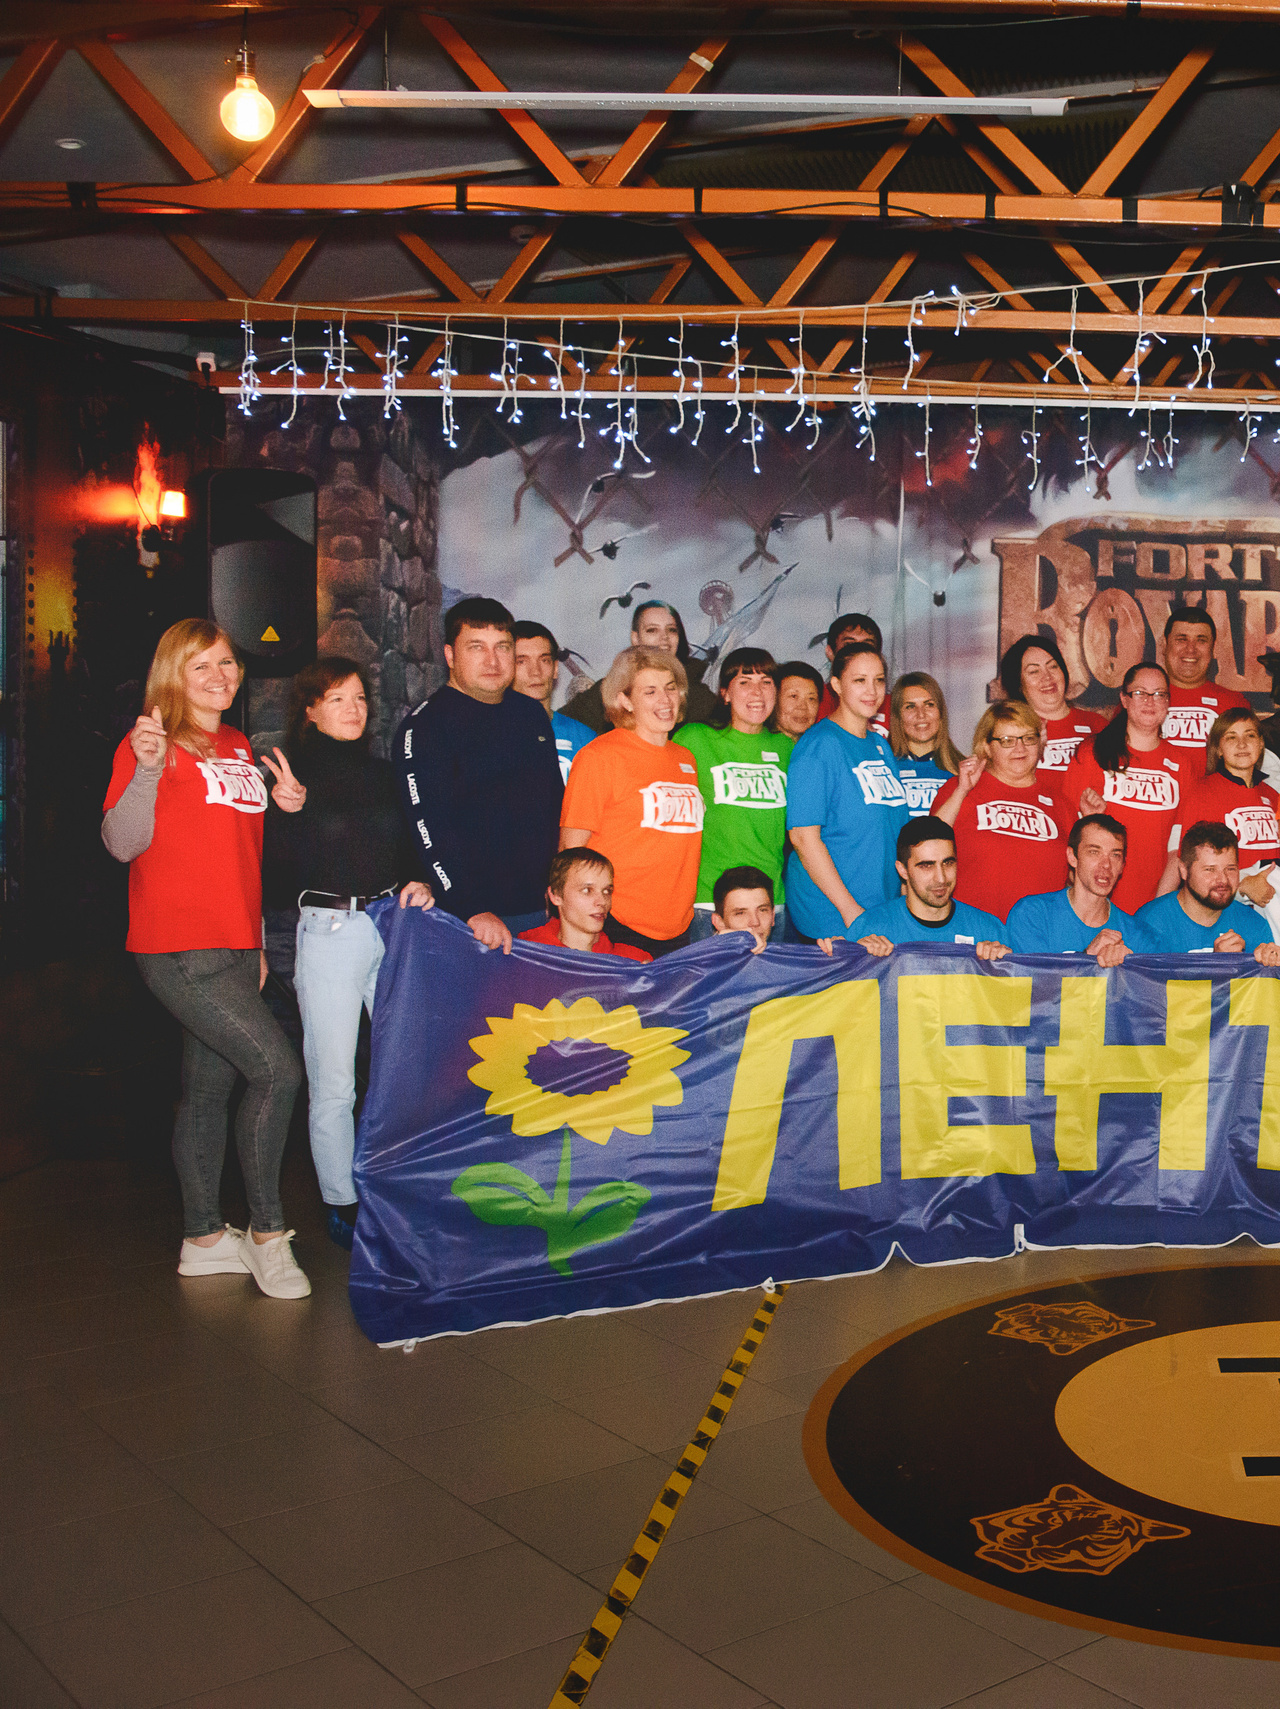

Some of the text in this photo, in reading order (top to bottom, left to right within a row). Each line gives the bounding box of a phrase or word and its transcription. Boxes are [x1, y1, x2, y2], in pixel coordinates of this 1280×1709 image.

[1097, 538, 1276, 583] FORT
[733, 768, 771, 778] FORT
[407, 773, 420, 805] LACOSTE
[976, 802, 1058, 839] BOYARD
[996, 804, 1034, 818] FORT
[433, 861, 451, 891] LACOSTE
